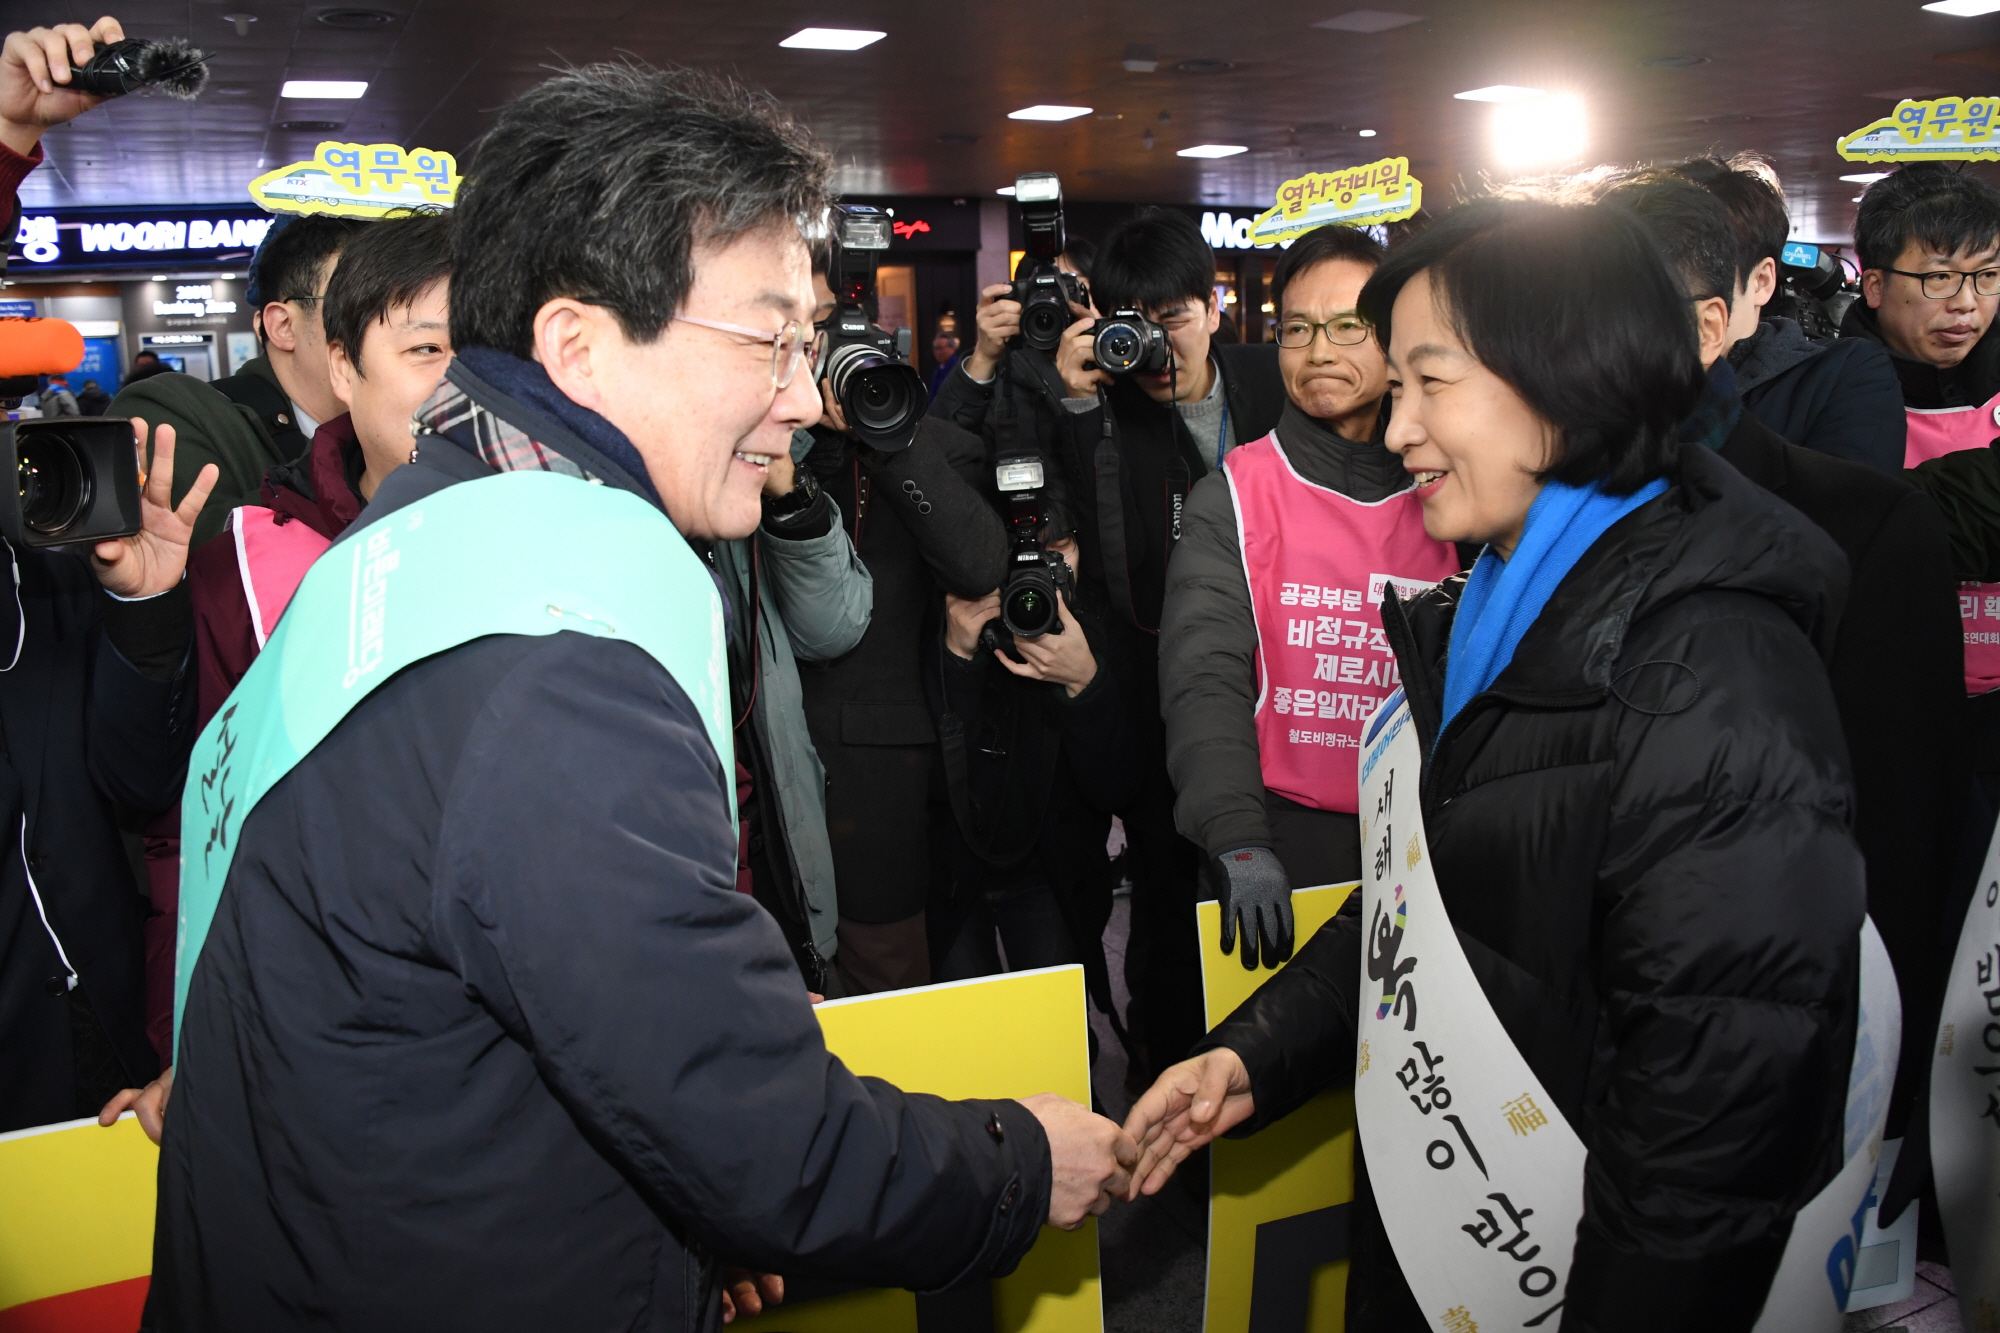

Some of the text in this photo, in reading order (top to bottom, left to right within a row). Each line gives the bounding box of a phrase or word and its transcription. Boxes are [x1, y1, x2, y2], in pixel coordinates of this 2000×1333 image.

[1899, 103, 1994, 139] 역무원
[286, 178, 309, 187] KTX
[324, 148, 451, 194] 역무원
[1282, 164, 1402, 214] 열차정비원
[1270, 215, 1284, 224] KTX
[81, 221, 188, 252] WOORI
[1784, 250, 1813, 261] CHANNEL
[842, 323, 866, 331] Canon
[1171, 493, 1183, 541] Canon
[1017, 554, 1039, 562] Nikon
[341, 526, 401, 690] 바른미래당
[1280, 582, 1363, 612] 공공부문
[1289, 729, 1362, 748] 철도비정규노
[1373, 767, 1395, 881] 새해
[1395, 1040, 1490, 1182] 많이
[1500, 1092, 1549, 1137] 福
